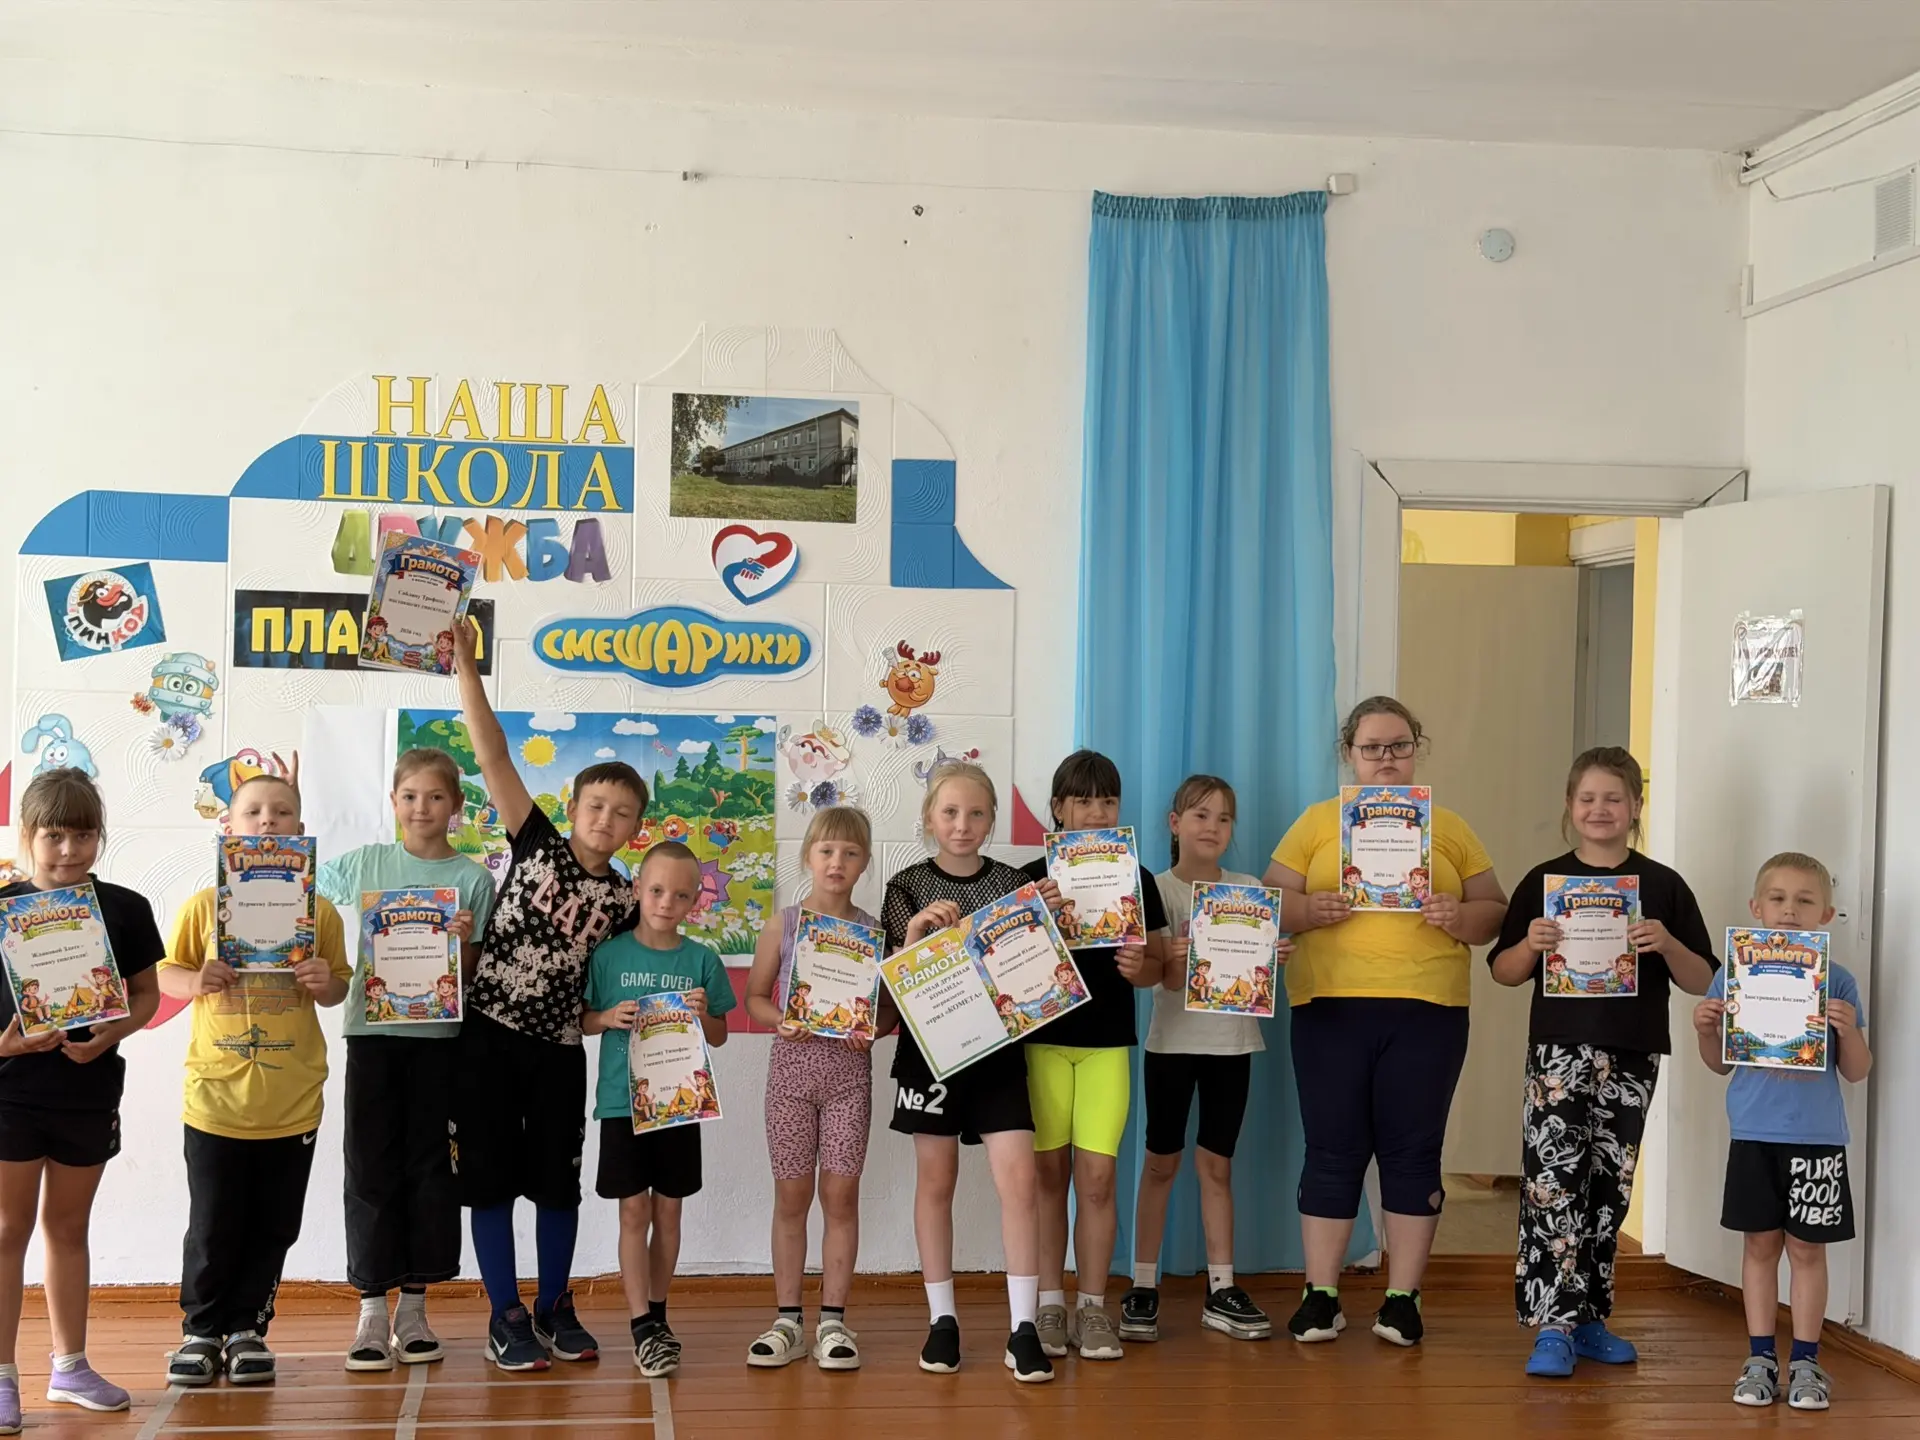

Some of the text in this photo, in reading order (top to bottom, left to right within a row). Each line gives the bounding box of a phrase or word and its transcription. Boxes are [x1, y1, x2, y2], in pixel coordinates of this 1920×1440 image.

[372, 375, 625, 443] НАША
[317, 440, 623, 510] ШКОЛА
[400, 555, 459, 581] Грамота
[542, 619, 801, 675] СМЕШАРИКИ
[1358, 804, 1415, 818] Грамота
[234, 852, 300, 870] Грамота
[1057, 842, 1128, 860] Грамота
[1203, 898, 1272, 920] Грамота
[1564, 895, 1622, 908] Грамота
[6, 905, 91, 932] Грамота
[381, 908, 441, 925] Грамота
[978, 911, 1033, 945] Грамота
[808, 925, 875, 958] Грамота
[1743, 946, 1813, 965] Грамота
[621, 972, 693, 991] GAME OVER
[894, 948, 970, 994] ГРАМОТА
[928, 981, 963, 1001] КОМАНДА»
[945, 992, 983, 1014] «КОМЕТА»
[1789, 1152, 1843, 1180] PURE
[1788, 1178, 1840, 1205] GOOD
[1788, 1199, 1843, 1226] VIBES
